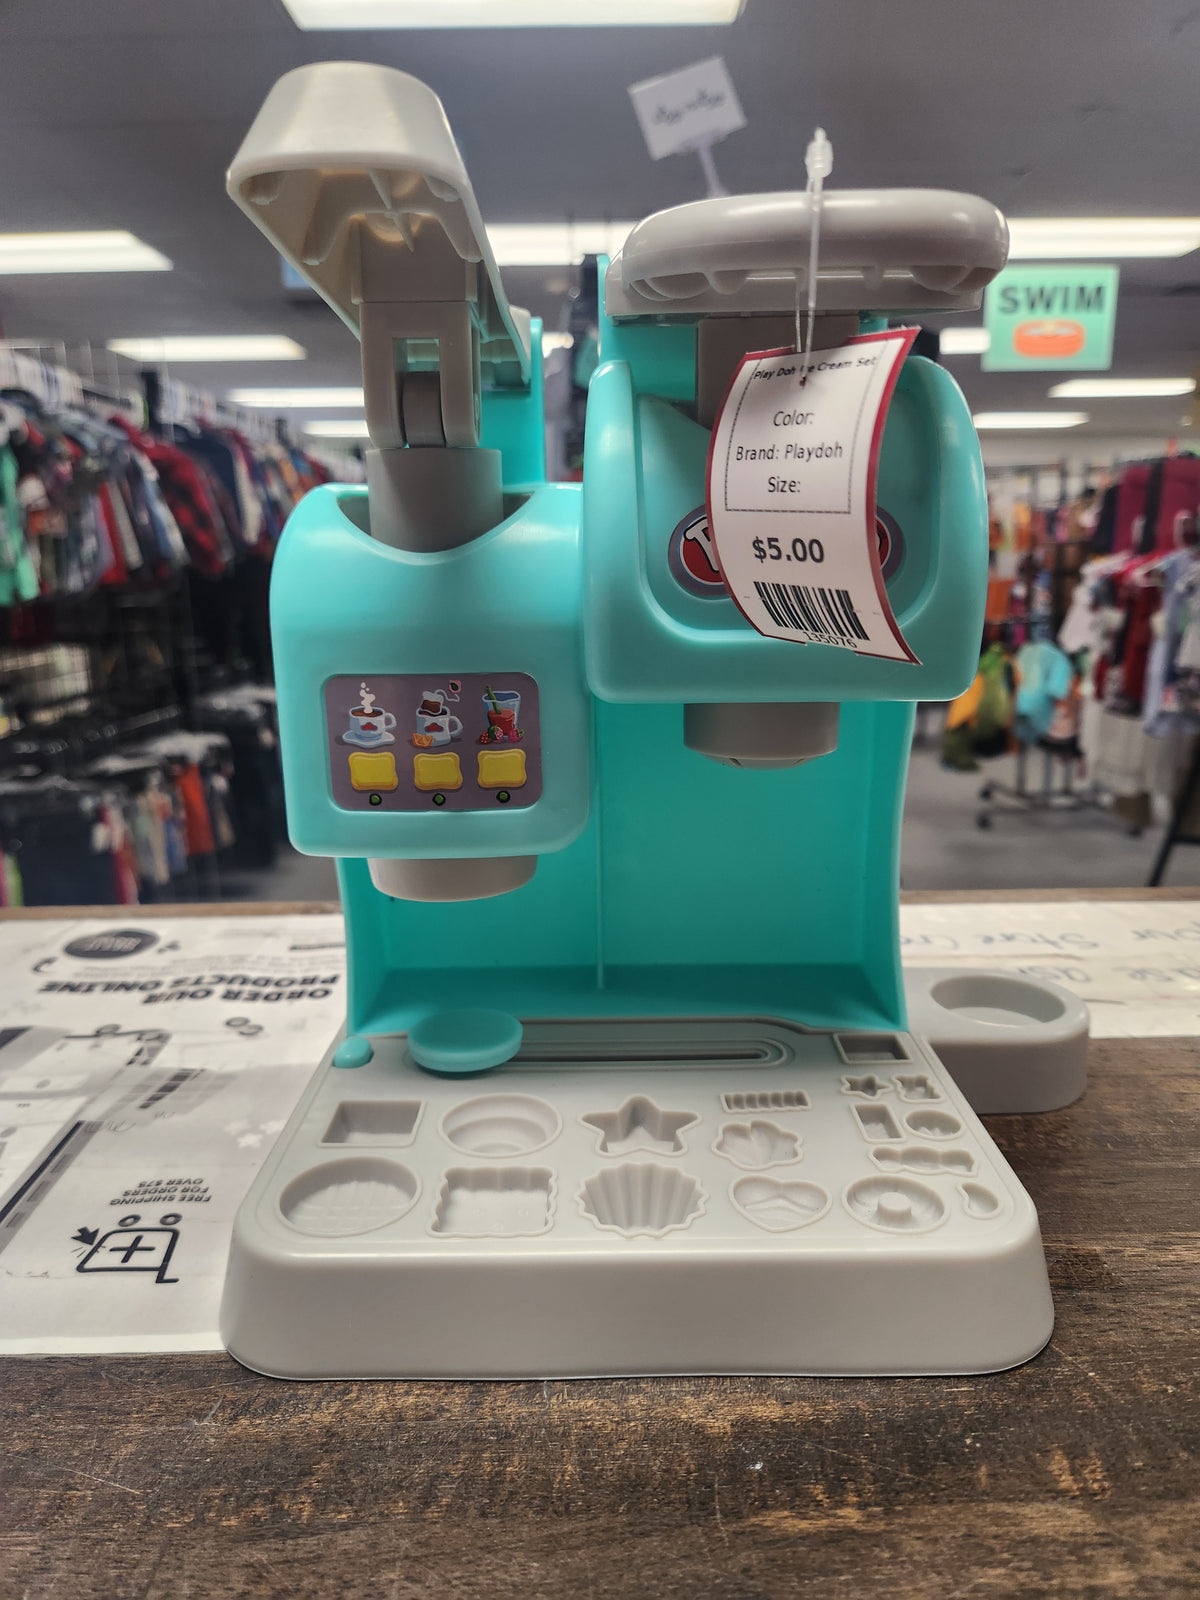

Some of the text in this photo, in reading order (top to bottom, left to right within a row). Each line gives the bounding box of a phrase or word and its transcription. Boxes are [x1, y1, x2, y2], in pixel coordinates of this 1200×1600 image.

[999, 286, 1105, 315] SWIM
[754, 369, 775, 380] Play
[800, 363, 815, 374] Ie
[817, 360, 852, 371] Cream
[856, 356, 878, 367] Set
[773, 409, 815, 427] Color:
[736, 441, 844, 463] Brand: Playdoh
[767, 475, 801, 493] Size:
[752, 536, 825, 563] $5.00
[803, 631, 858, 649] 135076
[38, 973, 340, 994] PRODUCTS ONLINE
[142, 988, 332, 1005] ORDER OUR
[166, 1178, 204, 1186] OVER
[109, 1194, 212, 1206] FREE SHIPPING
[122, 1186, 210, 1197] FOR ORDERS
